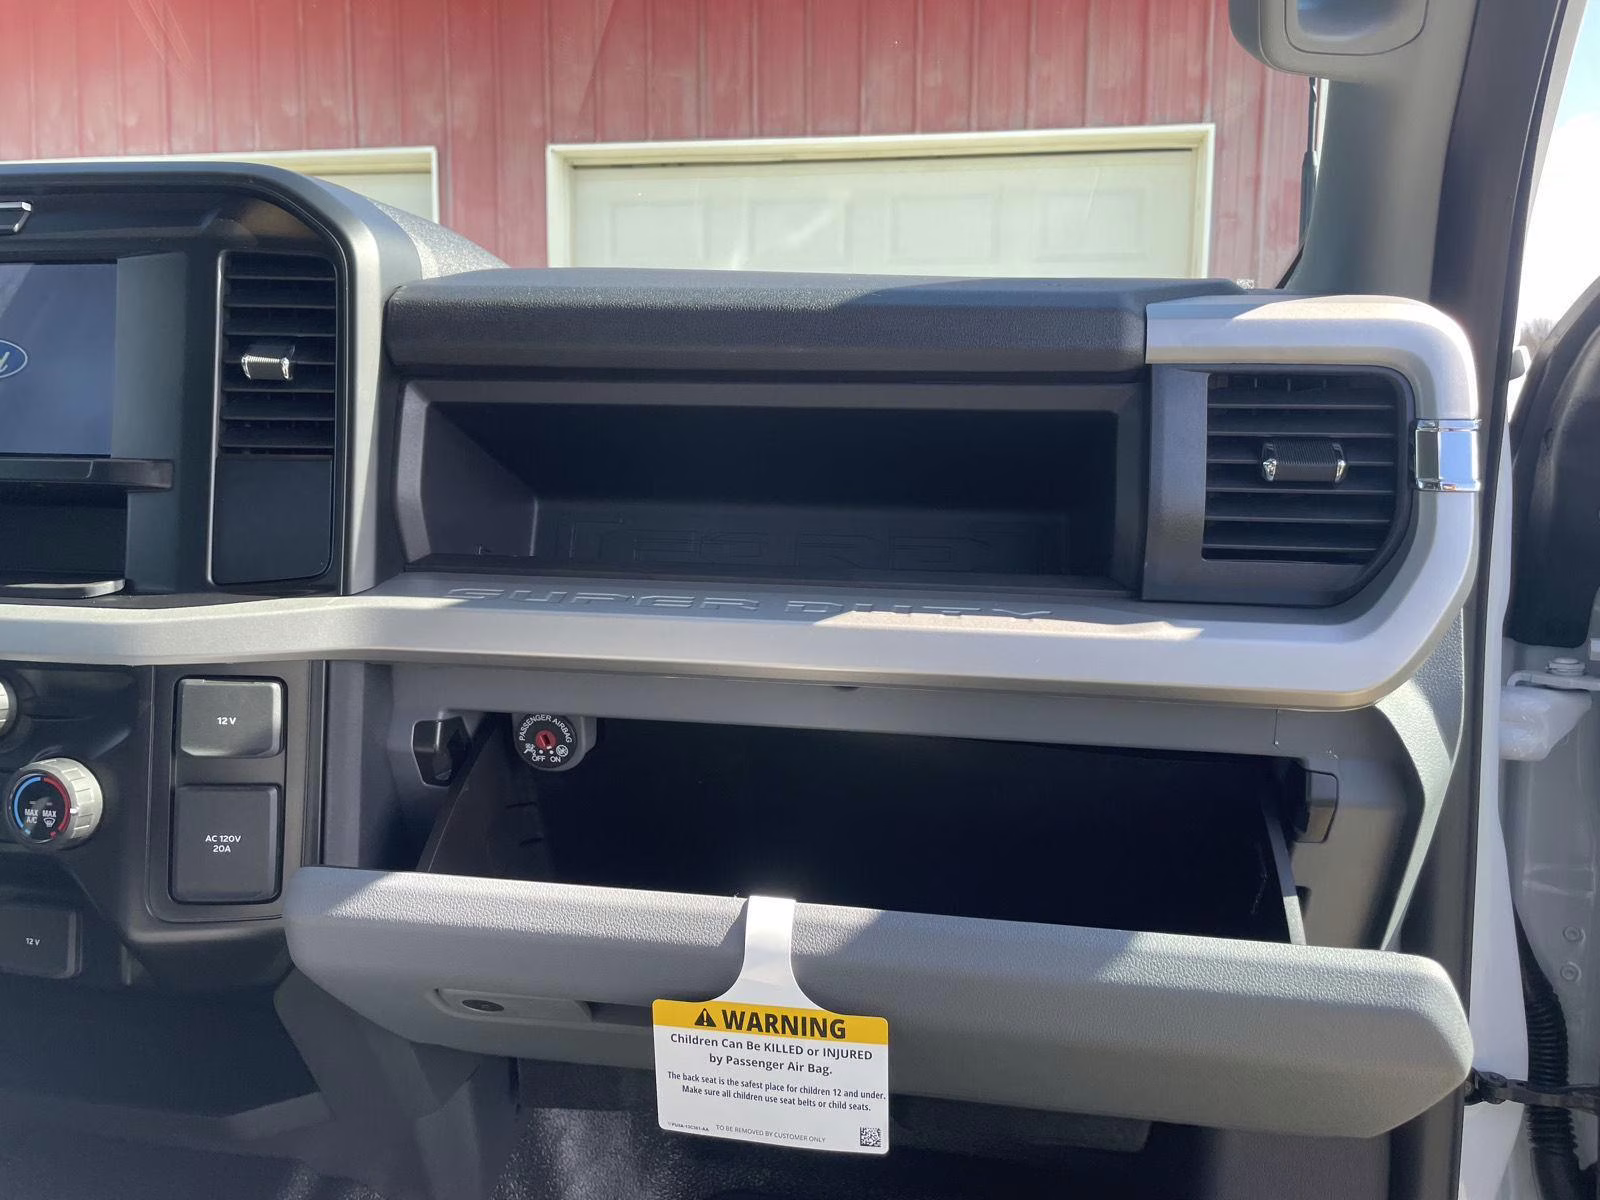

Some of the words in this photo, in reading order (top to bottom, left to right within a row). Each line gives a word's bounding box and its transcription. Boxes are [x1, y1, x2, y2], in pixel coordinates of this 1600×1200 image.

[446, 587, 760, 611] SUPER
[784, 600, 1053, 621] DUTY
[217, 717, 229, 725] 12
[229, 717, 237, 725] V
[518, 714, 552, 741] PASSENGER
[552, 718, 573, 743] AIRBAG
[24, 808, 39, 816] MAX
[42, 810, 57, 818] MAX
[26, 816, 38, 824] A/C
[205, 835, 218, 843] AC
[219, 835, 241, 843] 120V
[213, 845, 231, 853] 20A
[26, 937, 34, 945] 12
[34, 938, 40, 946] V
[721, 1009, 846, 1039] WARNING
[670, 1033, 718, 1047] Children
[721, 1038, 743, 1049] Can
[746, 1041, 761, 1051] Be
[764, 1042, 804, 1055] KILLED
[807, 1048, 820, 1056] or
[823, 1047, 873, 1060] INJURED
[709, 1053, 723, 1066] by
[726, 1055, 784, 1071] Passenger
[787, 1061, 804, 1072] Air
[808, 1064, 833, 1076] Bag.
[668, 1071, 681, 1080] The
[683, 1073, 700, 1082] back
[701, 1076, 717, 1084] seat
[719, 1077, 725, 1085] is
[726, 1078, 739, 1087] the
[741, 1079, 763, 1090] safest
[765, 1082, 785, 1092] place
[786, 1084, 798, 1093] for
[799, 1086, 830, 1096] children
[832, 1088, 842, 1097] 12
[844, 1090, 858, 1098] and
[860, 1091, 886, 1100] under.
[682, 1085, 702, 1094] Make
[704, 1088, 720, 1097] sure
[722, 1090, 731, 1098] all
[733, 1091, 763, 1102] children
[764, 1096, 778, 1104] use
[779, 1097, 796, 1106] seat
[797, 1098, 816, 1107] belts
[828, 1100, 847, 1110] child
[849, 1103, 871, 1112] seats.
[734, 1126, 764, 1136] REMOVED
[774, 1131, 808, 1141] CUSTOMER
